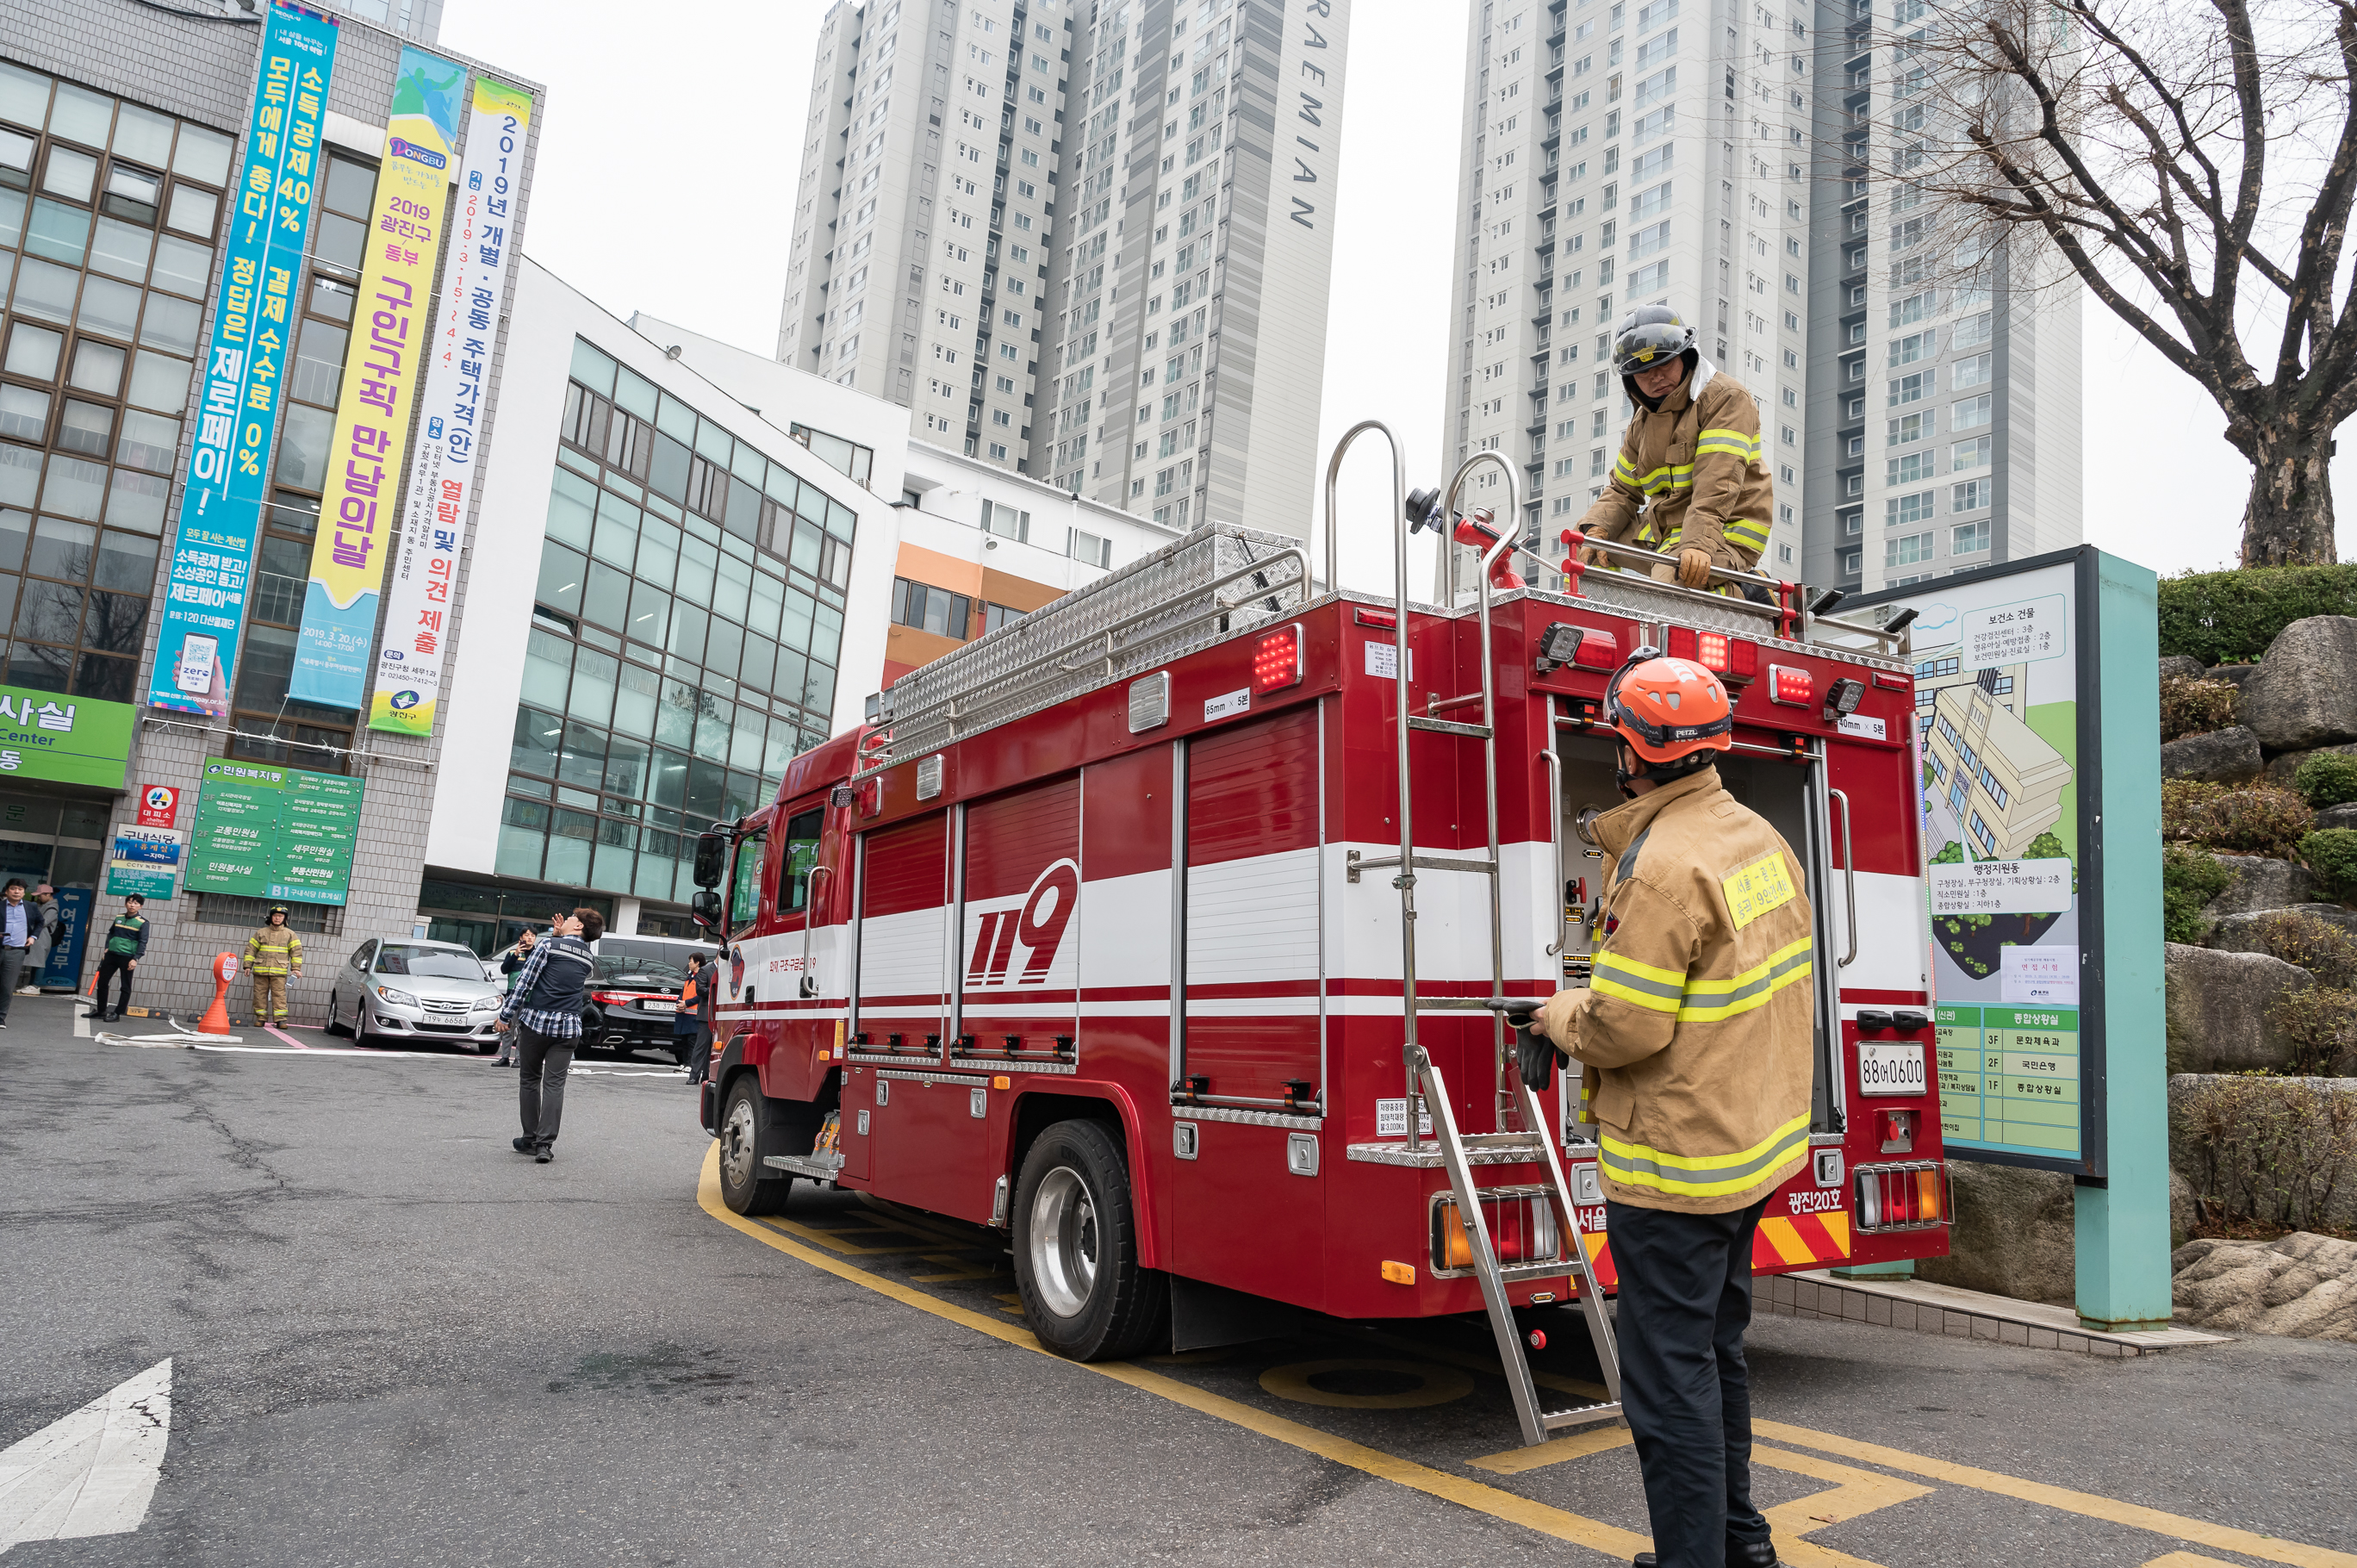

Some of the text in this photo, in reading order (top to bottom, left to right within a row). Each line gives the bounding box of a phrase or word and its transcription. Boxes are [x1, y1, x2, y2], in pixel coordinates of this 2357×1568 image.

[278, 35, 292, 46] 서울
[294, 40, 308, 52] 10년
[257, 55, 291, 160] 모두에게
[390, 137, 445, 169] DONGBU
[487, 115, 518, 219] 2019년
[470, 171, 482, 190] 기간
[243, 164, 272, 245] 좋다!
[389, 196, 431, 221] 2019
[380, 213, 432, 243] 광진구
[384, 243, 420, 267] 동부
[239, 66, 323, 476] 소득공제 40% 결제 수수료 0%
[223, 256, 256, 343] 정답은
[359, 274, 414, 419] 구인구직
[429, 417, 443, 439] 장소
[432, 445, 444, 470] 인터넷
[414, 500, 421, 509] 및
[437, 478, 463, 526] 열람
[185, 527, 246, 549] 모두 잘 사는 계산법
[434, 528, 456, 553] 및
[175, 548, 248, 574] 소득공제 받고!
[401, 547, 414, 581] 주민센터
[172, 564, 246, 589] 소상공인 돕고!
[425, 557, 453, 604] 의견
[199, 614, 236, 630] 다산콜재단
[1988, 607, 2036, 625] 보건소 건물
[302, 626, 326, 640] 2019.
[328, 632, 336, 642] 3.
[414, 607, 443, 656] 제출
[1974, 624, 2034, 643] 건강검진센터 3층
[2039, 631, 2051, 640] 2층
[2039, 641, 2050, 650] 1층
[299, 656, 325, 668] 서울특별시
[385, 650, 402, 661] 문의
[183, 667, 209, 677] zero
[381, 661, 437, 678] 광진구청 세무1과
[182, 694, 227, 706] zeropay.or.kr
[1206, 694, 1248, 715] 65mm 5본
[388, 710, 418, 720] 광진구
[1675, 729, 1699, 738] PETZL
[1838, 718, 1884, 735] 40mm 5본
[0, 728, 56, 747] Center
[222, 764, 283, 783] 민원복지동
[202, 793, 216, 802] 3F
[142, 809, 171, 819] 대피소
[123, 830, 176, 845] 구내식당
[214, 825, 259, 839] 교통민원실
[292, 843, 335, 857] 세무민원실
[191, 867, 203, 875] 1F
[208, 862, 253, 876] 민원봉사실
[290, 866, 334, 879] 부동산민원실
[1974, 862, 2020, 875] 행정지원동
[1937, 874, 2061, 888] 구청장실, 부구청장실, 2층
[271, 885, 289, 898] B1
[290, 889, 317, 899] 구내식당
[1937, 889, 1969, 899] 직소민원실
[1937, 899, 2001, 911] 종합상황실 지하1층
[965, 864, 1079, 986] 119
[559, 943, 581, 955] KOREA CIVIL
[444, 1017, 463, 1025] 6656
[1937, 1010, 1956, 1022] (신관)
[2013, 1012, 2059, 1026] 종합상황실
[1987, 1035, 1999, 1045] 3F
[2016, 1036, 2060, 1047] 문화체육과
[1987, 1058, 1999, 1067] 2F
[2022, 1061, 2056, 1072] 국민은행
[1863, 1059, 1923, 1084] 88어0600
[1950, 1083, 1976, 1092] 복지상담실
[1988, 1080, 1999, 1090] 1F
[2017, 1083, 2062, 1095] 종합상황실
[1380, 1113, 1404, 1122] 최대적재량
[1577, 1189, 1843, 1232] 서울 광진20호
